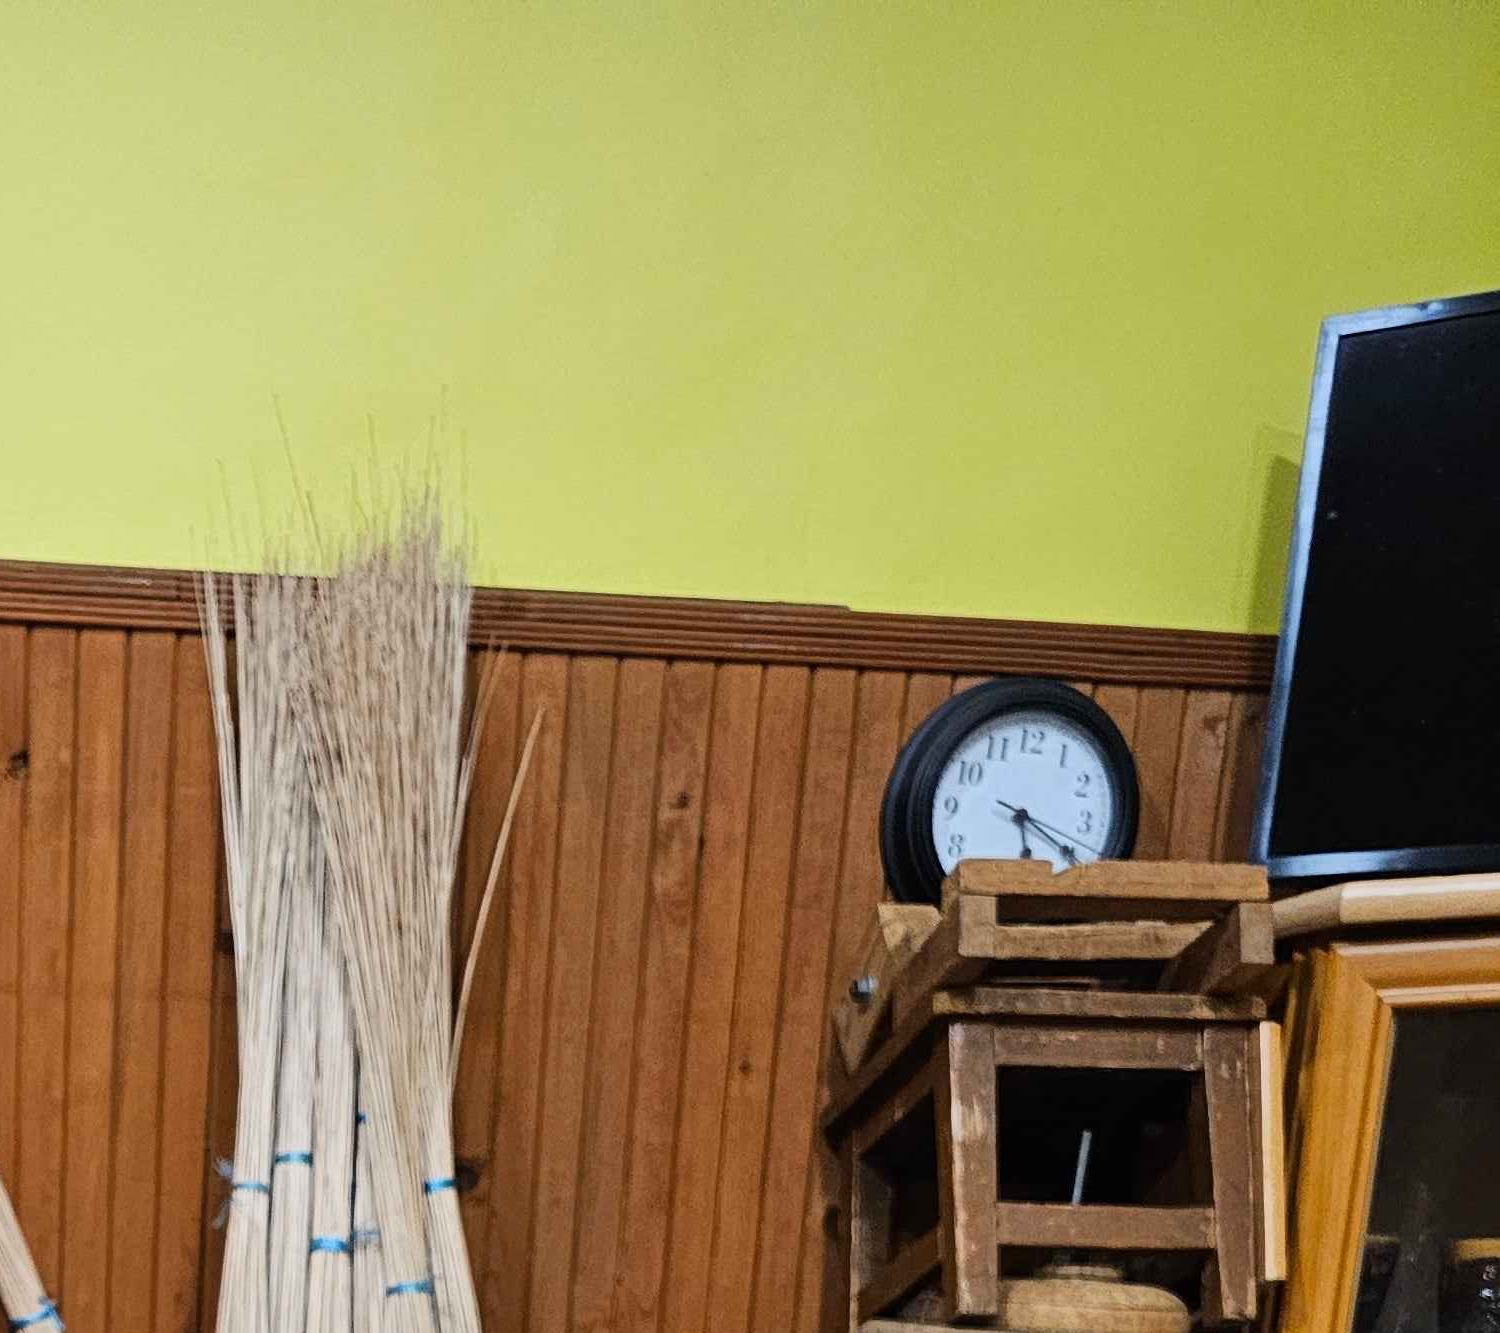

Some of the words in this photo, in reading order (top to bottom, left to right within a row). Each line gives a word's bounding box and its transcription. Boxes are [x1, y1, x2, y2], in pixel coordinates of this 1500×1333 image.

[986, 735, 1010, 761] 11
[1020, 729, 1045, 754] 12
[1060, 743, 1068, 769] 1
[958, 760, 983, 786] 10
[1074, 770, 1091, 799] 2
[943, 796, 959, 821] 9
[1076, 808, 1093, 837] 3
[947, 833, 965, 858] 8
